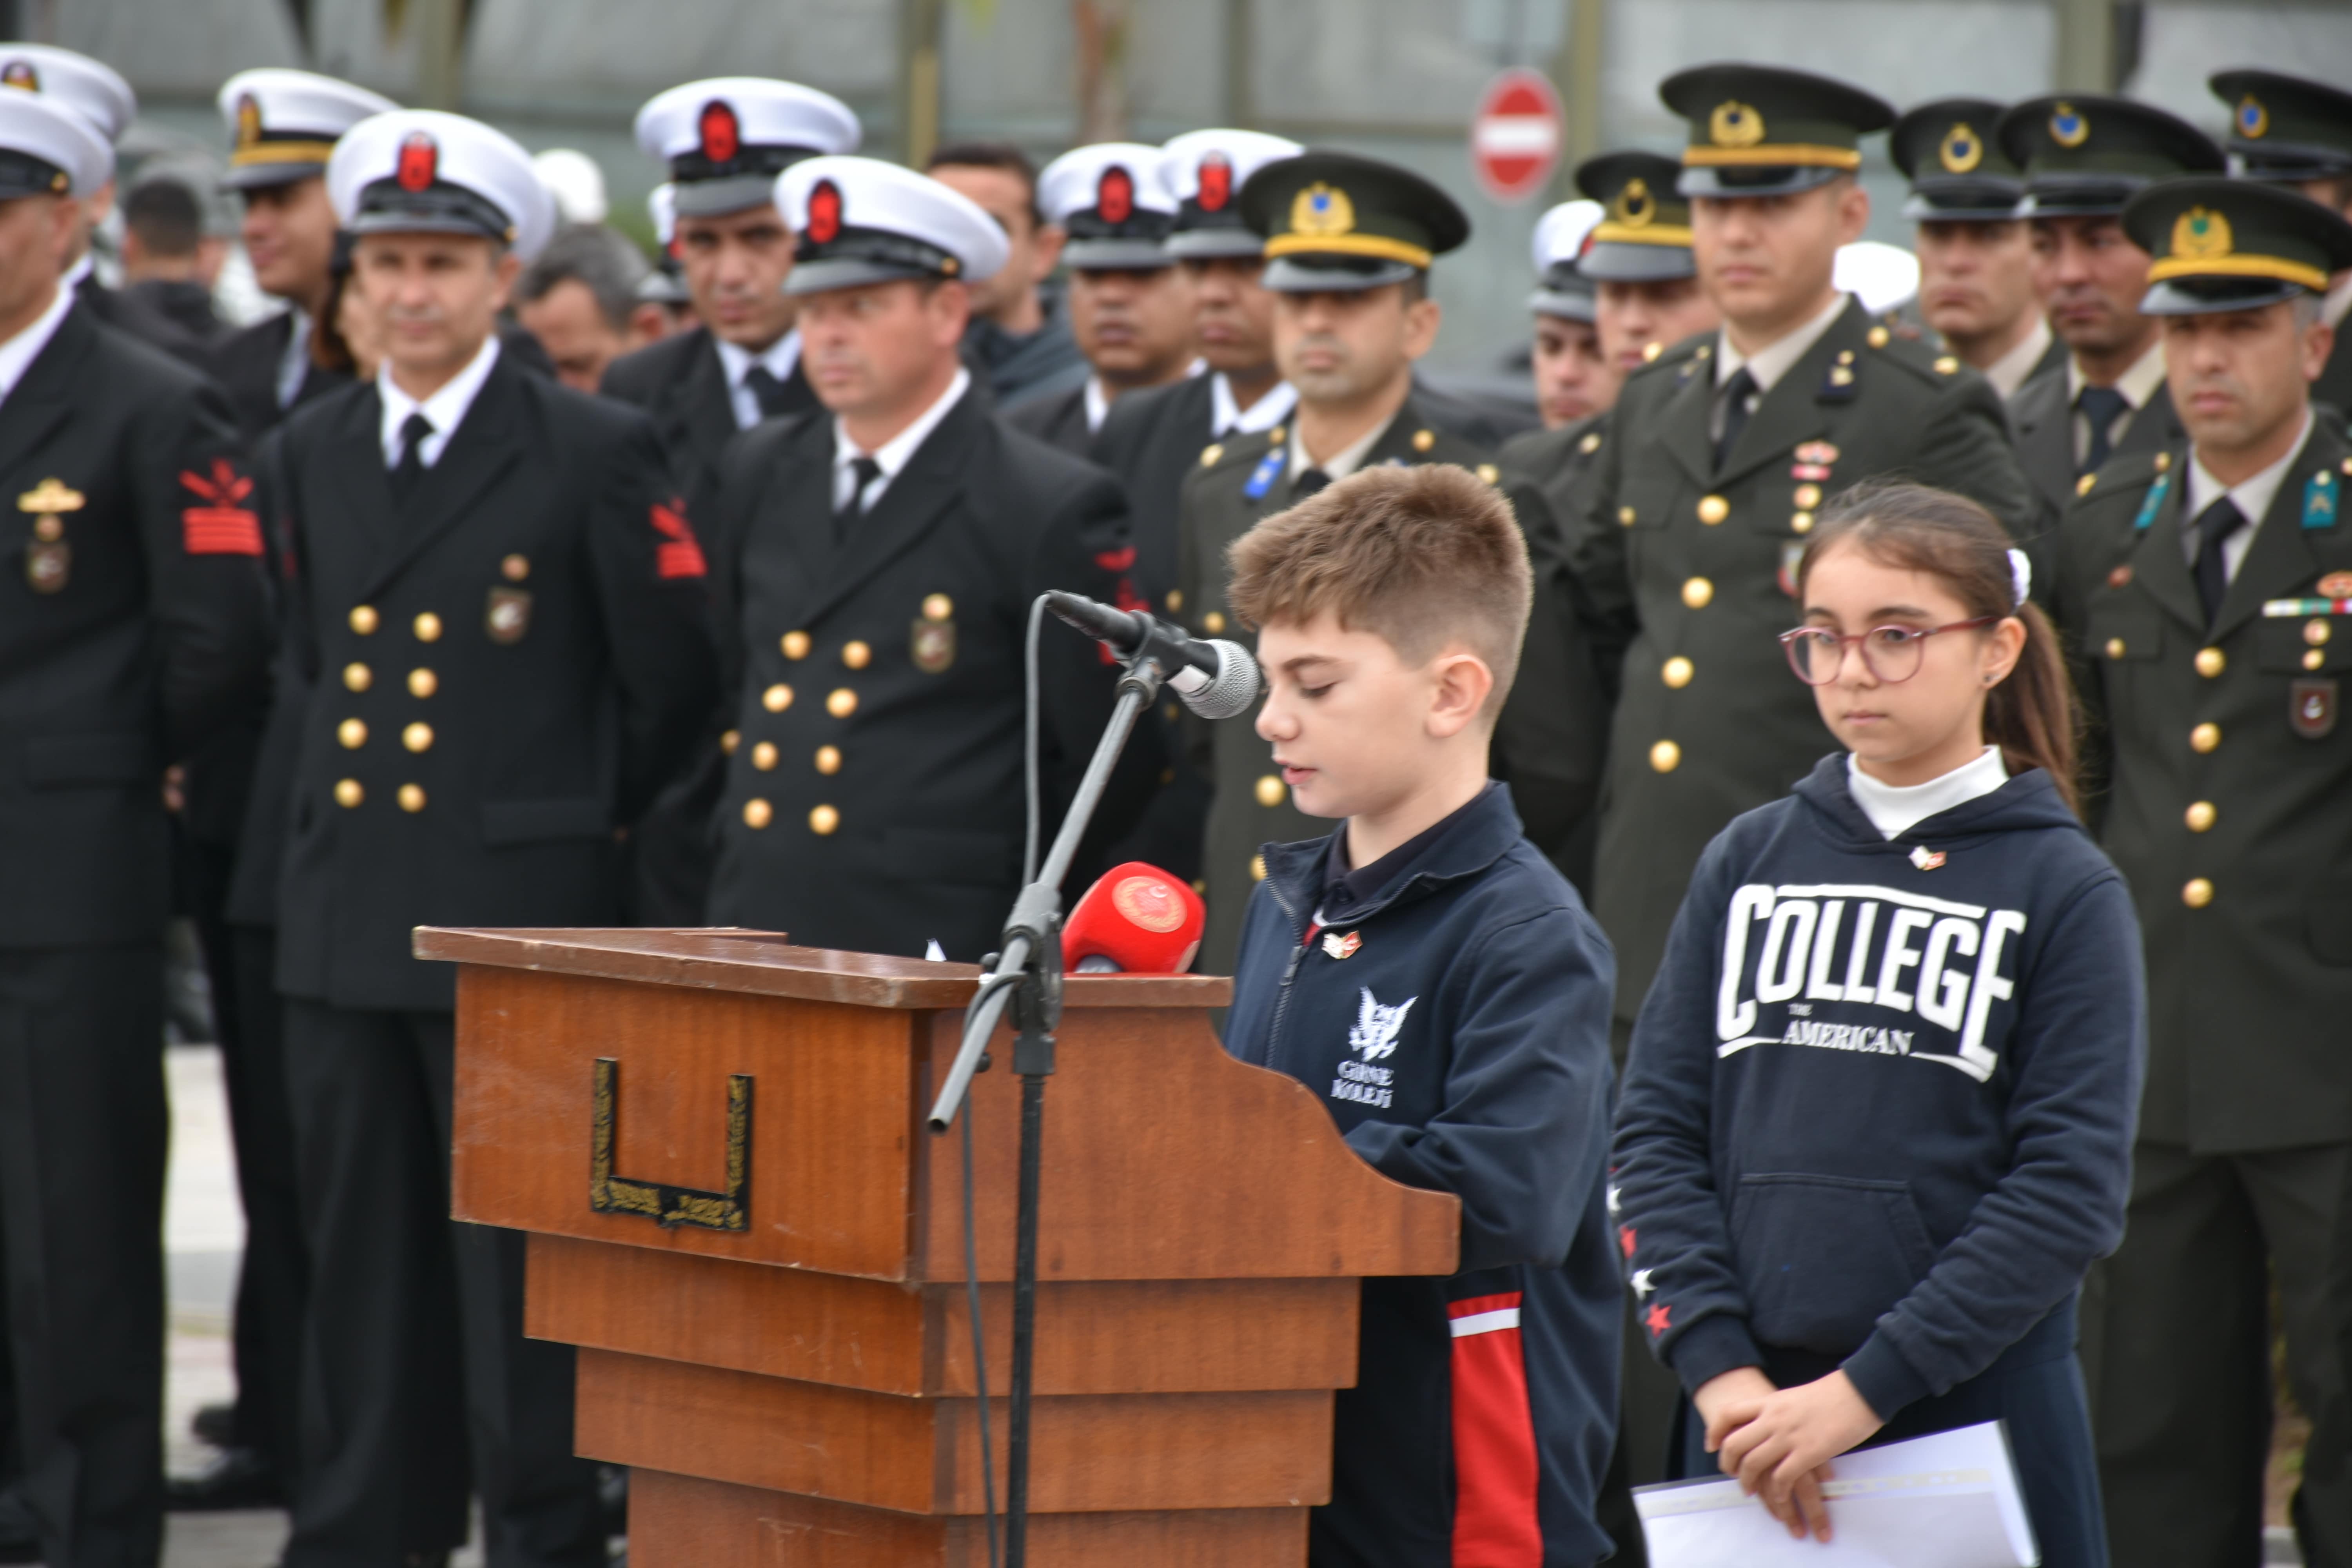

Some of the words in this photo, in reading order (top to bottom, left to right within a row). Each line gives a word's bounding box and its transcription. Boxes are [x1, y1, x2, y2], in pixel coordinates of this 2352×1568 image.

[1717, 884, 2027, 1075] COLLEGE
[1788, 1003, 1813, 1016] THE
[1781, 1020, 1915, 1056] AMERICAN
